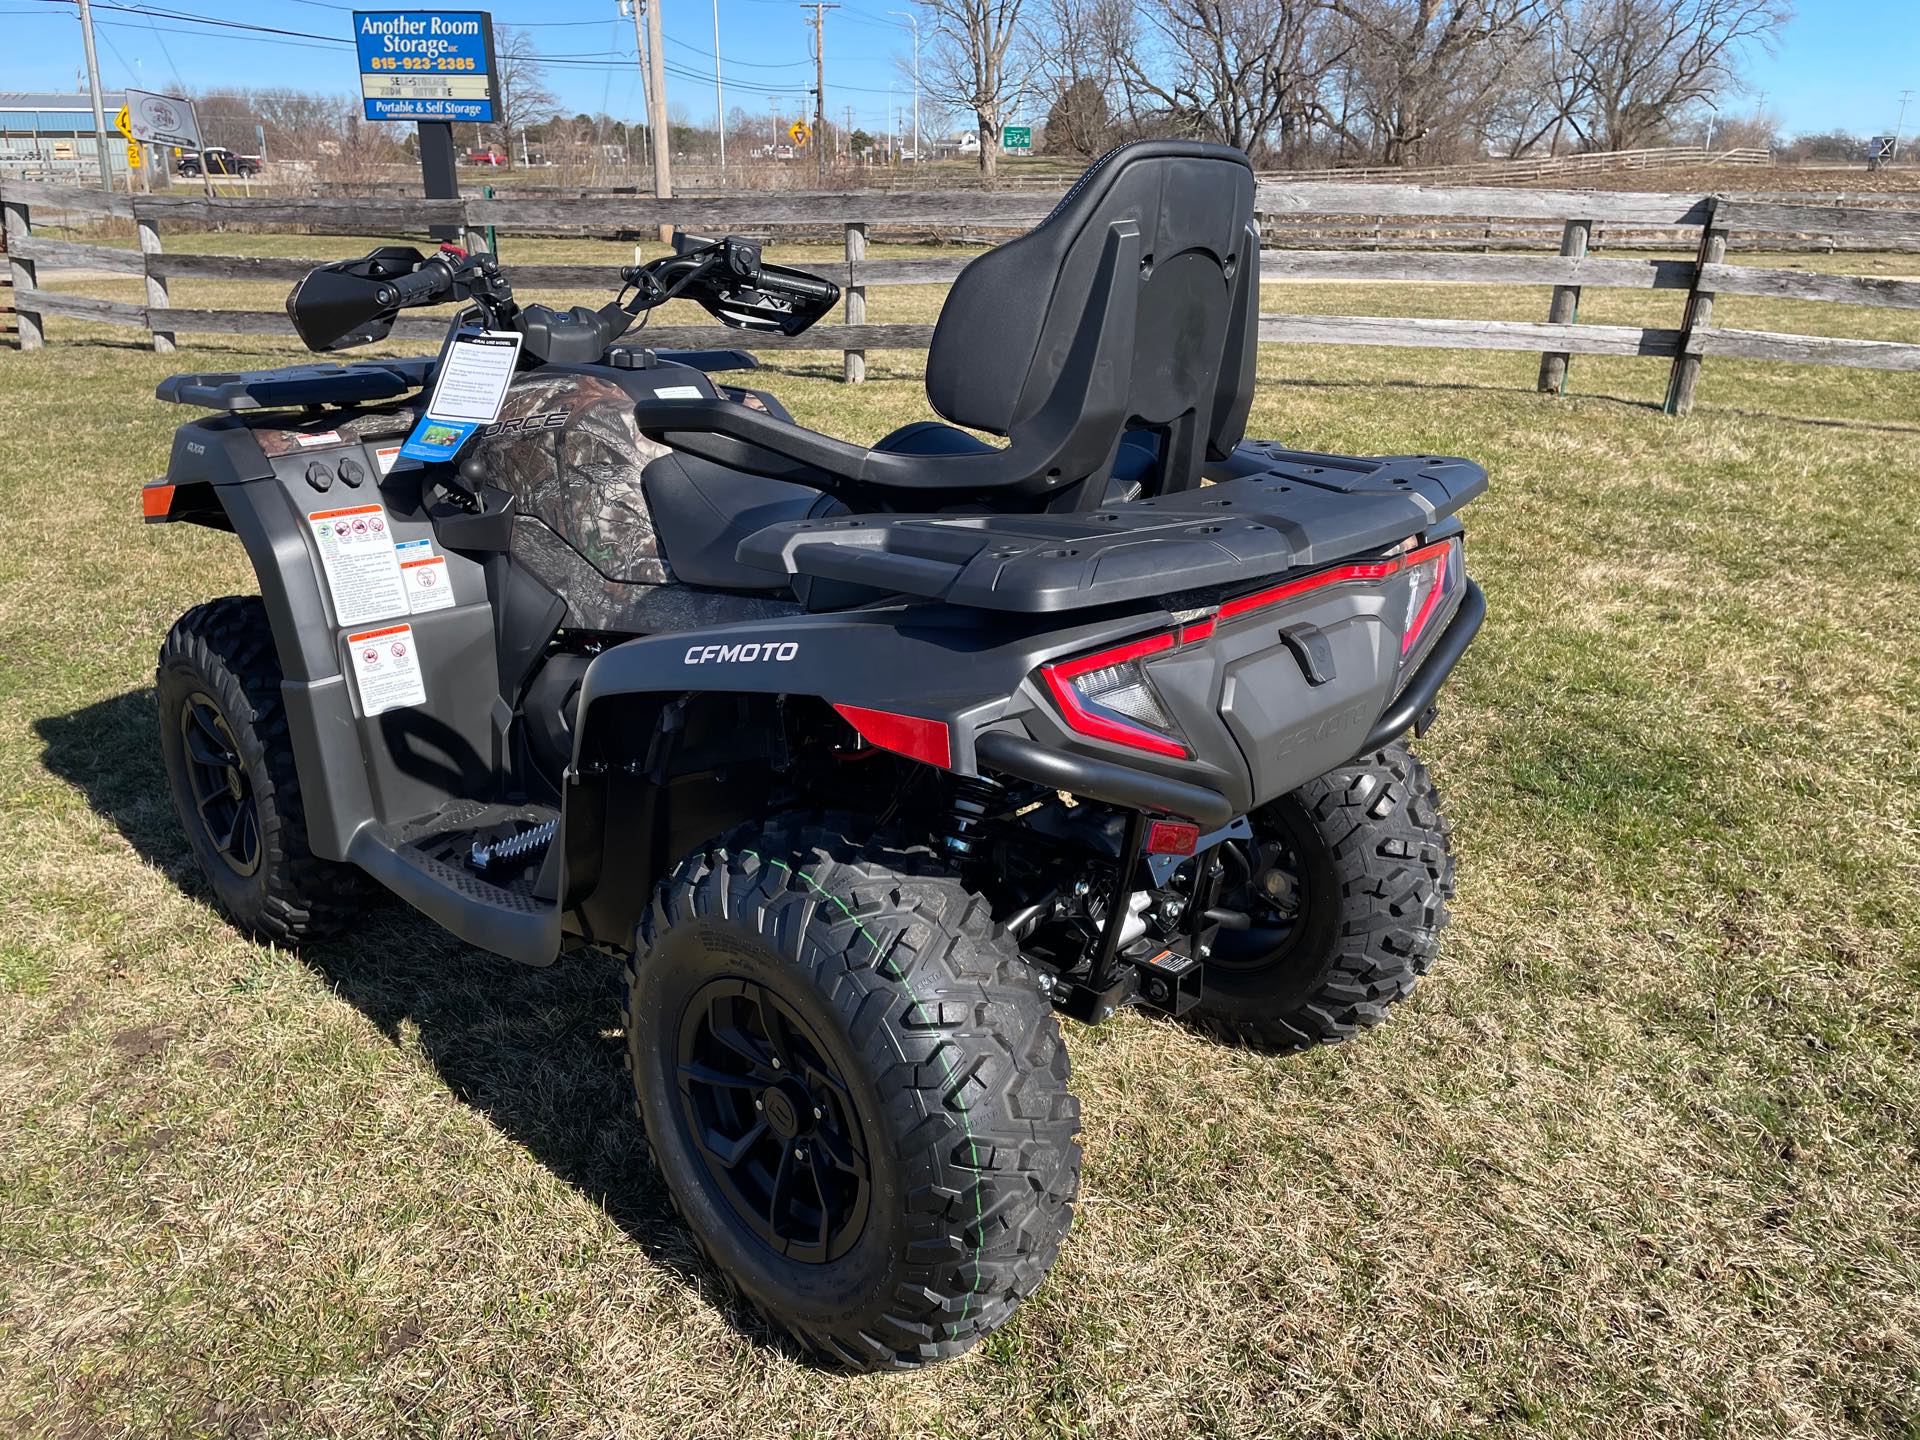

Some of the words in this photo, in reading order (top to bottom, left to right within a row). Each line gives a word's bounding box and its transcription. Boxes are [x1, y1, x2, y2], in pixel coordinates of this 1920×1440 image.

[361, 15, 426, 35] Another
[431, 16, 479, 35] Room
[383, 35, 448, 58] Storage
[371, 57, 475, 70] 815-923-2385
[376, 101, 414, 113] Portable
[416, 102, 424, 113] &
[425, 101, 444, 113] Self
[445, 102, 481, 117] Storage
[684, 642, 799, 665] CFMOTO
